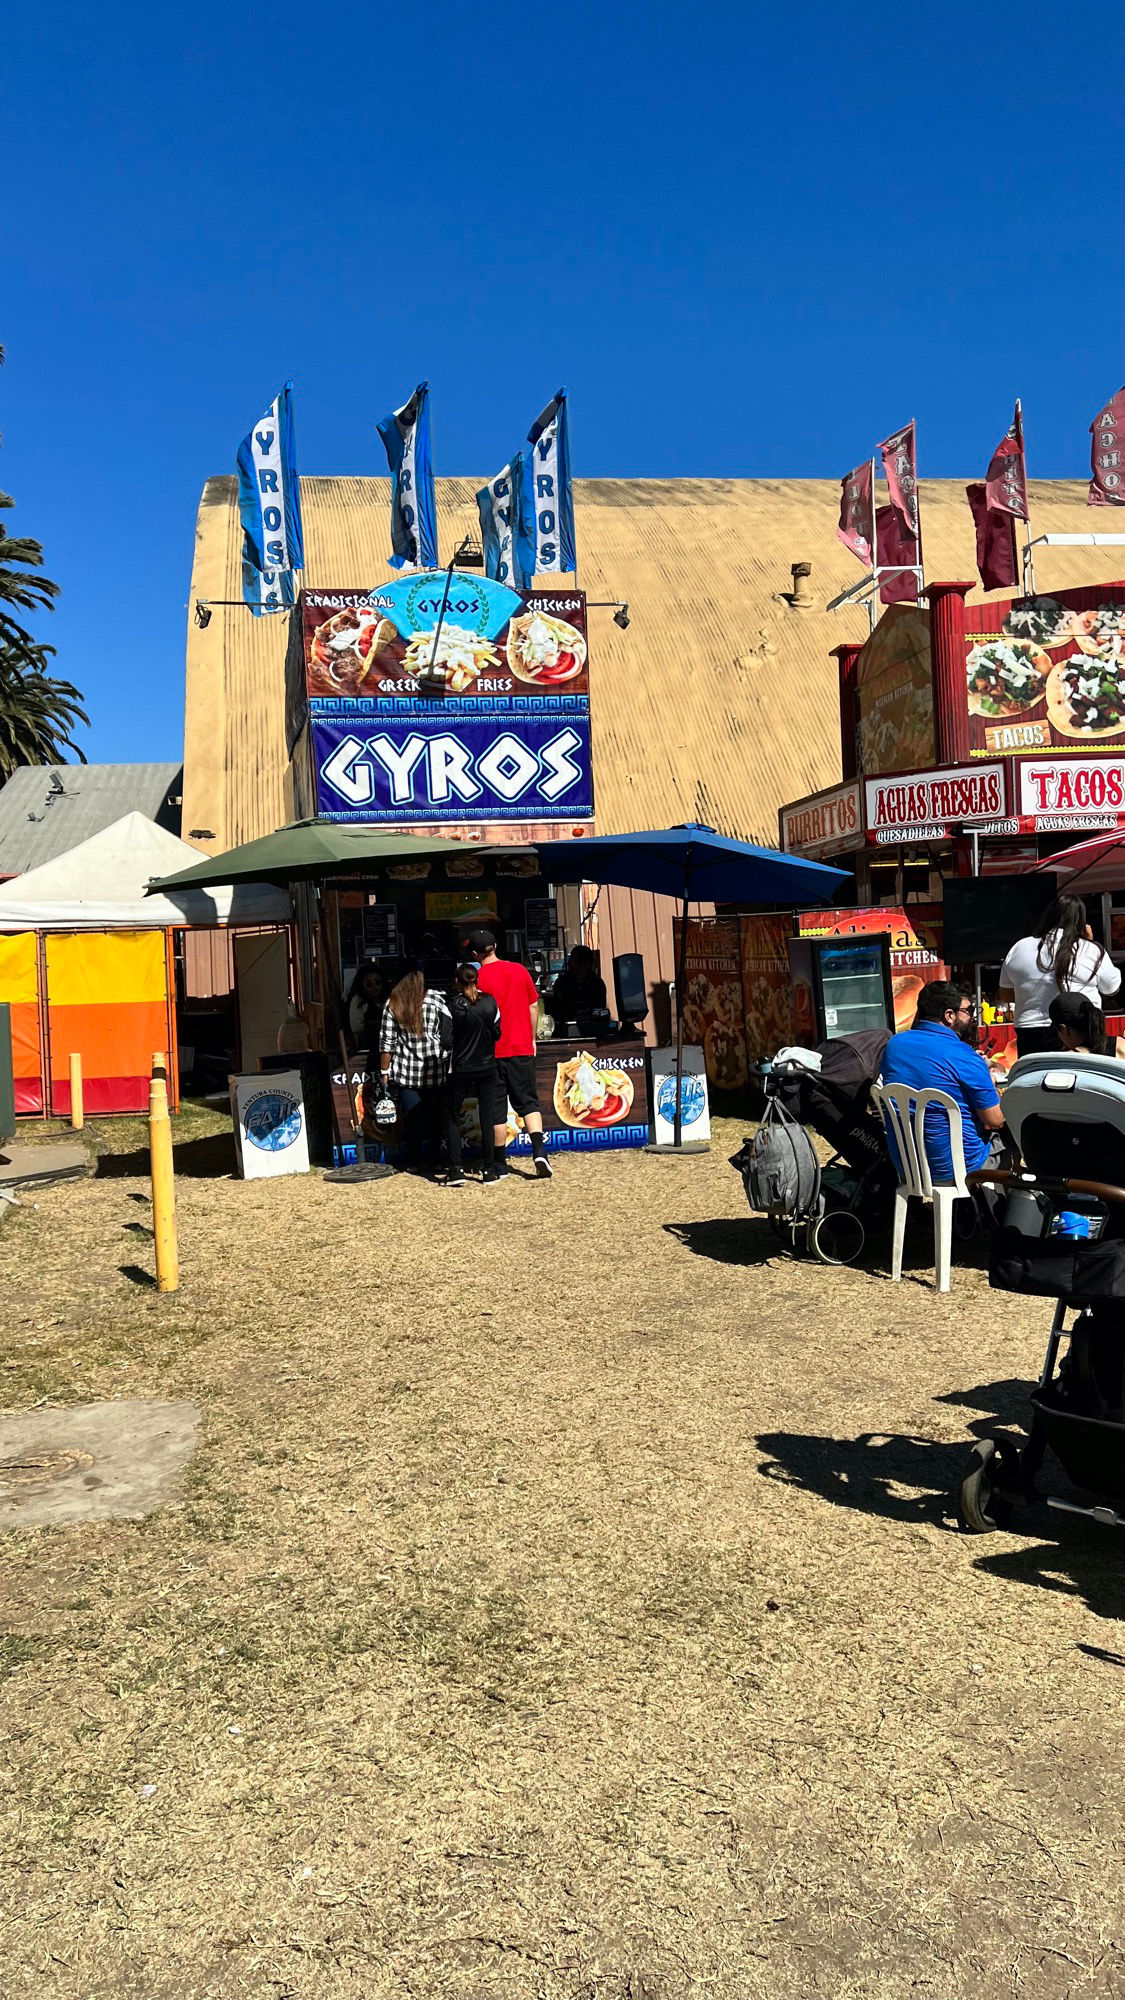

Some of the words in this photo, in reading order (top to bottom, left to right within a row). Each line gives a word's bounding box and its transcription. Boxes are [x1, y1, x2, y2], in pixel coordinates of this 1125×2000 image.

[255, 430, 284, 566] YROS
[536, 436, 556, 566] YROS
[305, 594, 396, 608] TRADITIONAL
[417, 599, 480, 613] GYROS
[526, 598, 581, 612] CHICKEN
[377, 678, 422, 692] GREEK
[477, 677, 513, 692] FRIES
[992, 723, 1046, 750] TACOS
[321, 727, 583, 806] GYROS
[1031, 768, 1123, 809] TACOS
[875, 783, 928, 826] AGUAS
[929, 772, 1001, 820] FRESCAS
[786, 792, 857, 849] BURRITOS
[1036, 816, 1071, 831] AGUAS
[1072, 814, 1117, 829] FRESCAS
[877, 824, 946, 844] QUESADILLAS
[889, 949, 939, 966] ITCHEN
[592, 1056, 644, 1071] CHICKEN
[242, 1090, 268, 1111] VENTURA
[268, 1088, 295, 1100] COUNTY
[246, 1099, 301, 1131] FAIR
[518, 1131, 551, 1145] FRS
